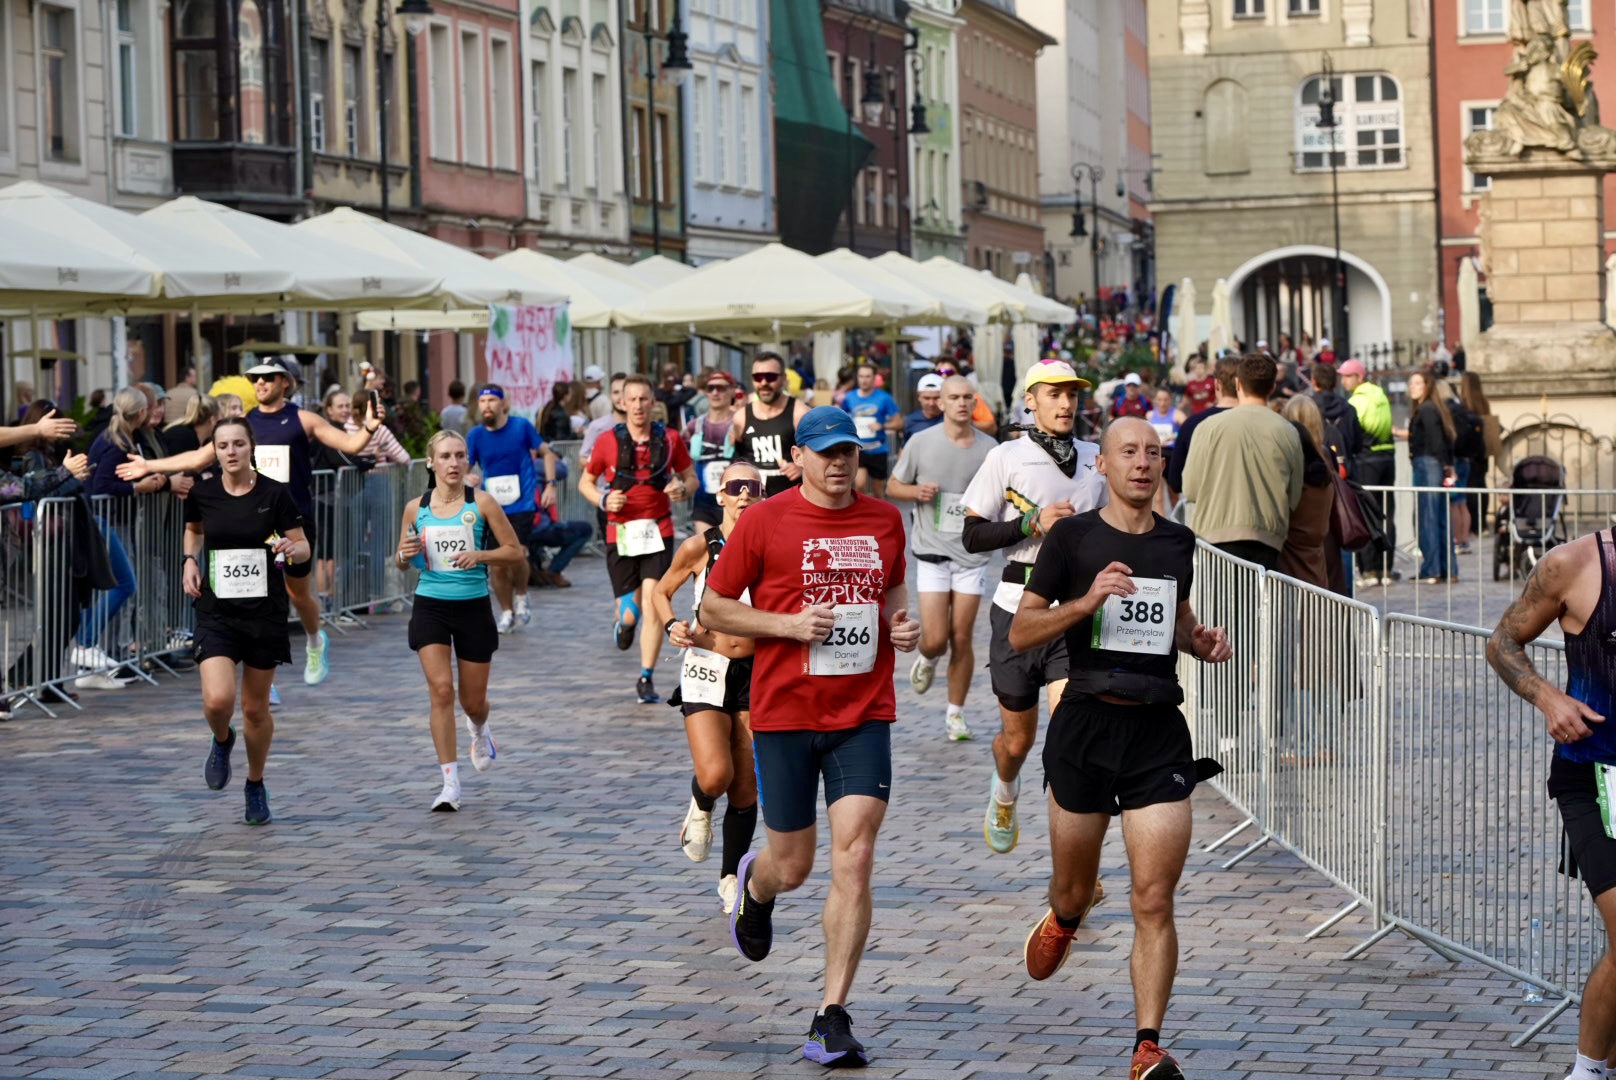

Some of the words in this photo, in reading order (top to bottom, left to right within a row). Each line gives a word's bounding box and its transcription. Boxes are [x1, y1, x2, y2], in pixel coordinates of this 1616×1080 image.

[260, 456, 280, 468] 871
[434, 539, 467, 553] 1992
[223, 564, 261, 578] 3634
[1120, 600, 1164, 624] 388
[822, 626, 871, 646] 2366
[1116, 626, 1165, 638] Przemysław
[834, 651, 860, 659] Daniel
